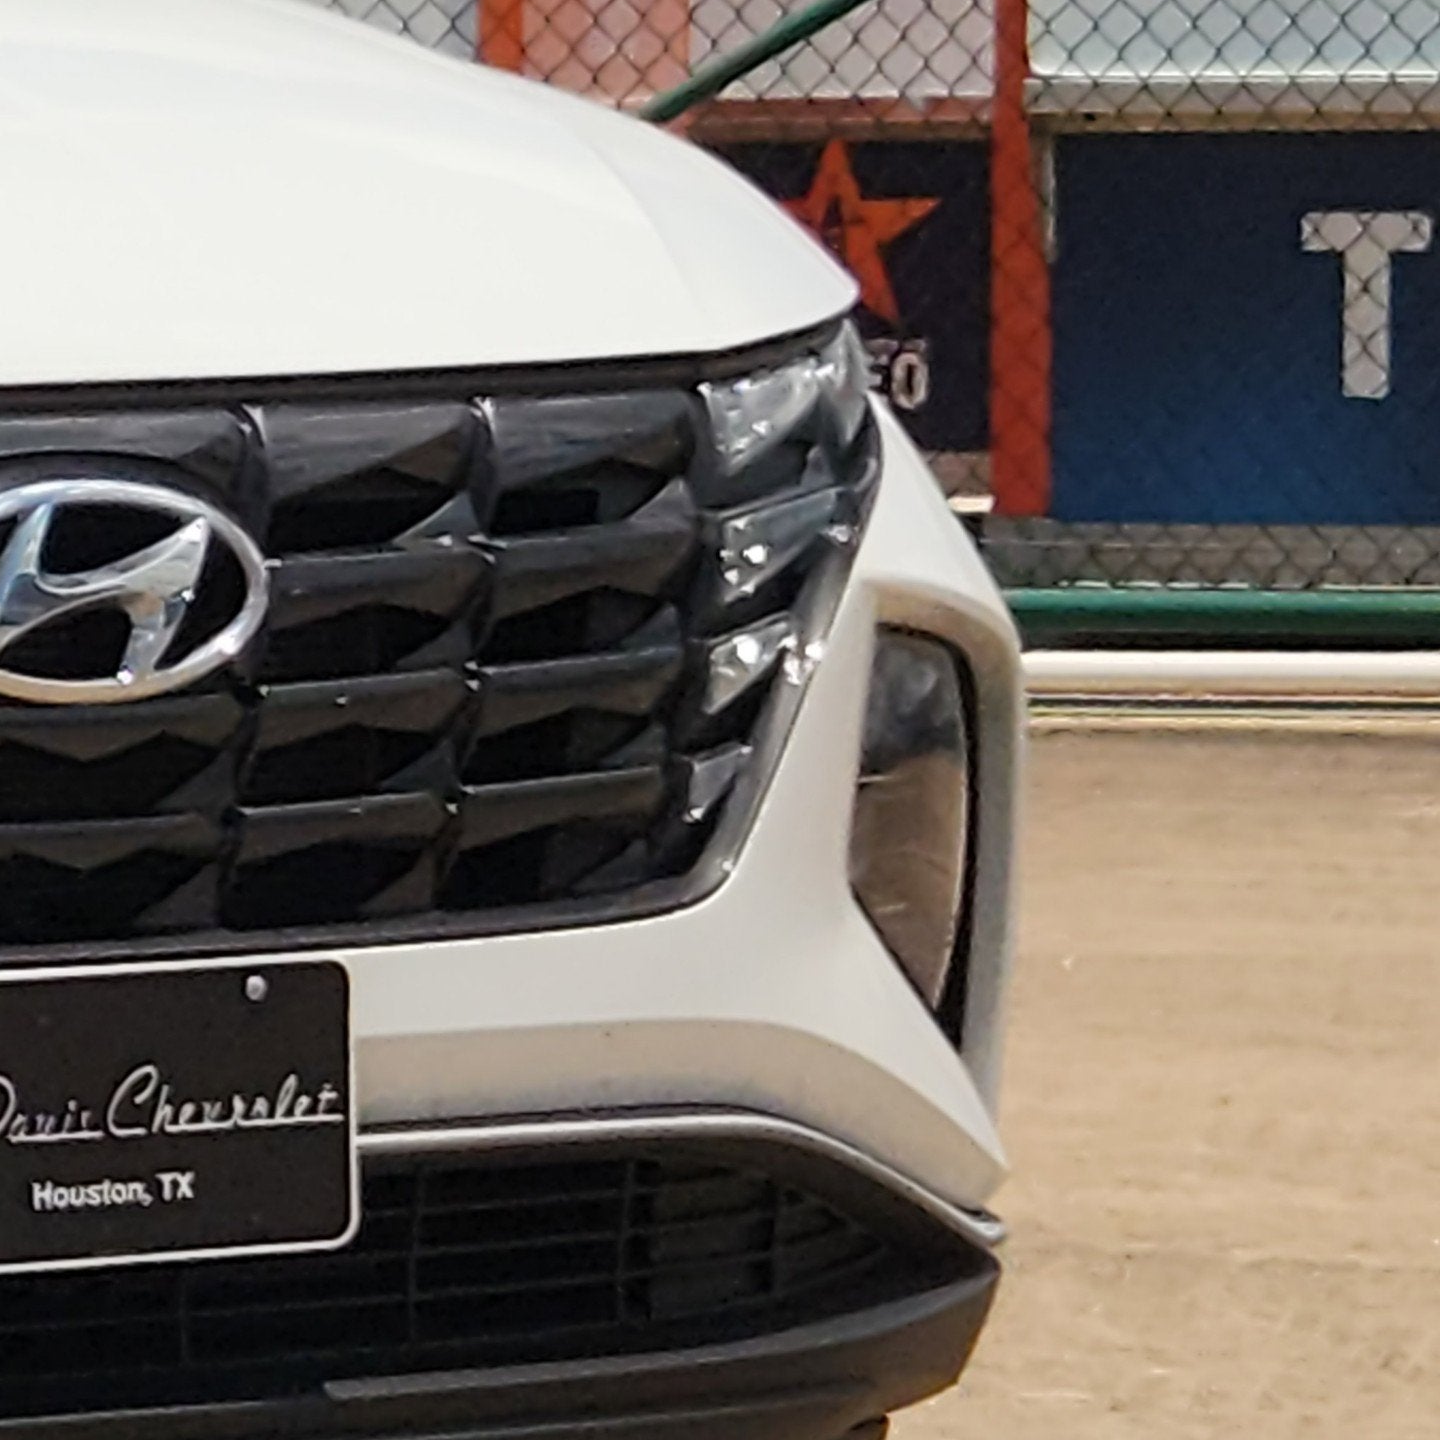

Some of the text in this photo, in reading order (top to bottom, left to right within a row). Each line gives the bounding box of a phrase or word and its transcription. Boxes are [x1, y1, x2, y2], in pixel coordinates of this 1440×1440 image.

[1300, 210, 1433, 401] T
[106, 1063, 345, 1137] Chevrolet
[31, 1170, 197, 1212] Houston, TX
